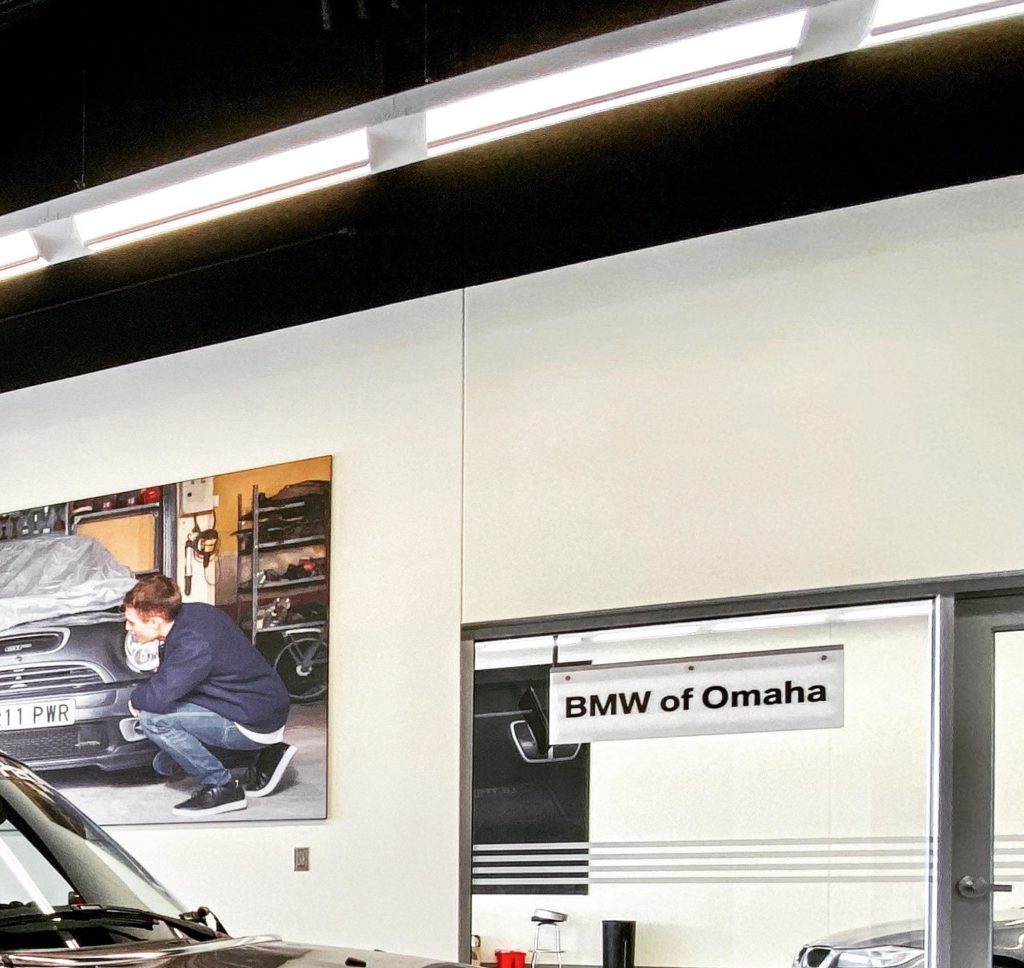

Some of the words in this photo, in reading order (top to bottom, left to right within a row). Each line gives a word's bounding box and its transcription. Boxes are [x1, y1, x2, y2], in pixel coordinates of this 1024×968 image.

[565, 690, 651, 718] BMW
[660, 687, 694, 712] of
[702, 681, 827, 709] Omaha
[33, 704, 70, 724] PWR
